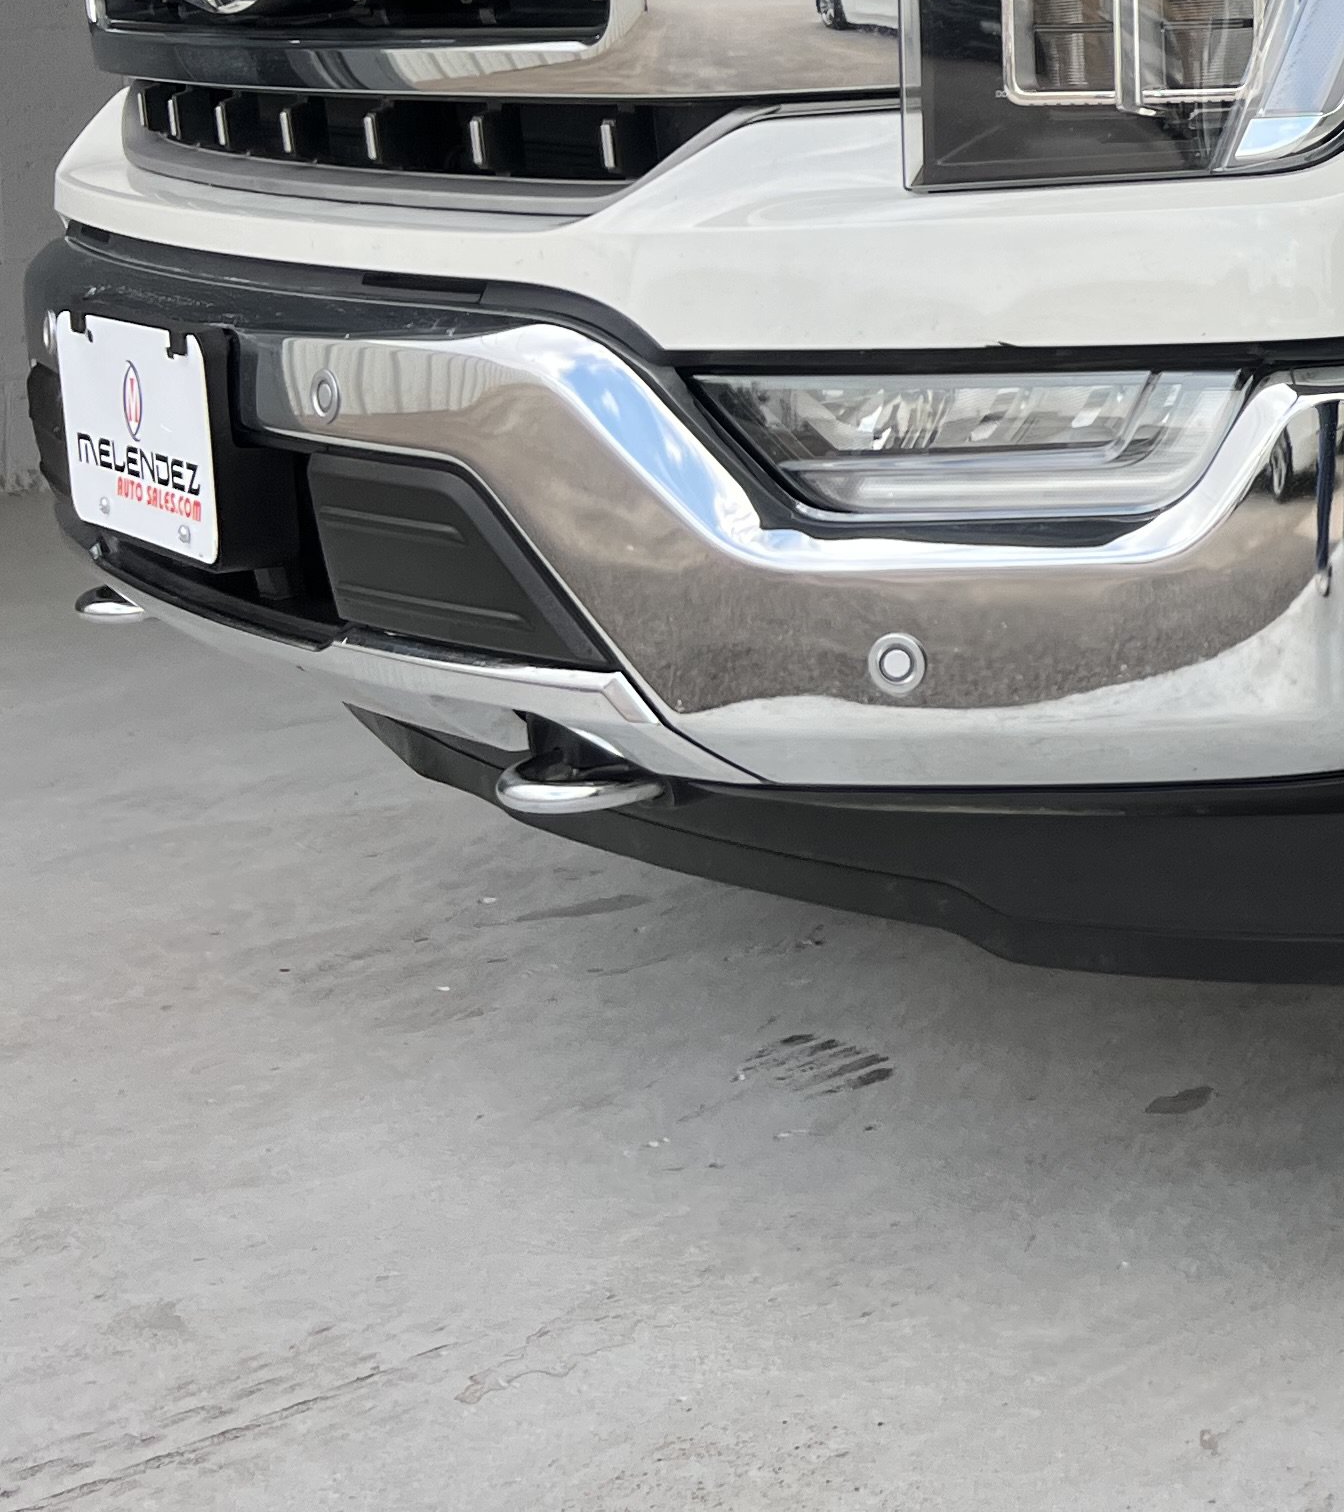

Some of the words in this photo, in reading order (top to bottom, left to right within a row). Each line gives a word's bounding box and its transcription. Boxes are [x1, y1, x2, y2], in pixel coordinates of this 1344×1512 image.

[76, 432, 201, 497] MELENDEZ
[116, 475, 144, 503] AUTO
[146, 485, 203, 523] SALES.COM
